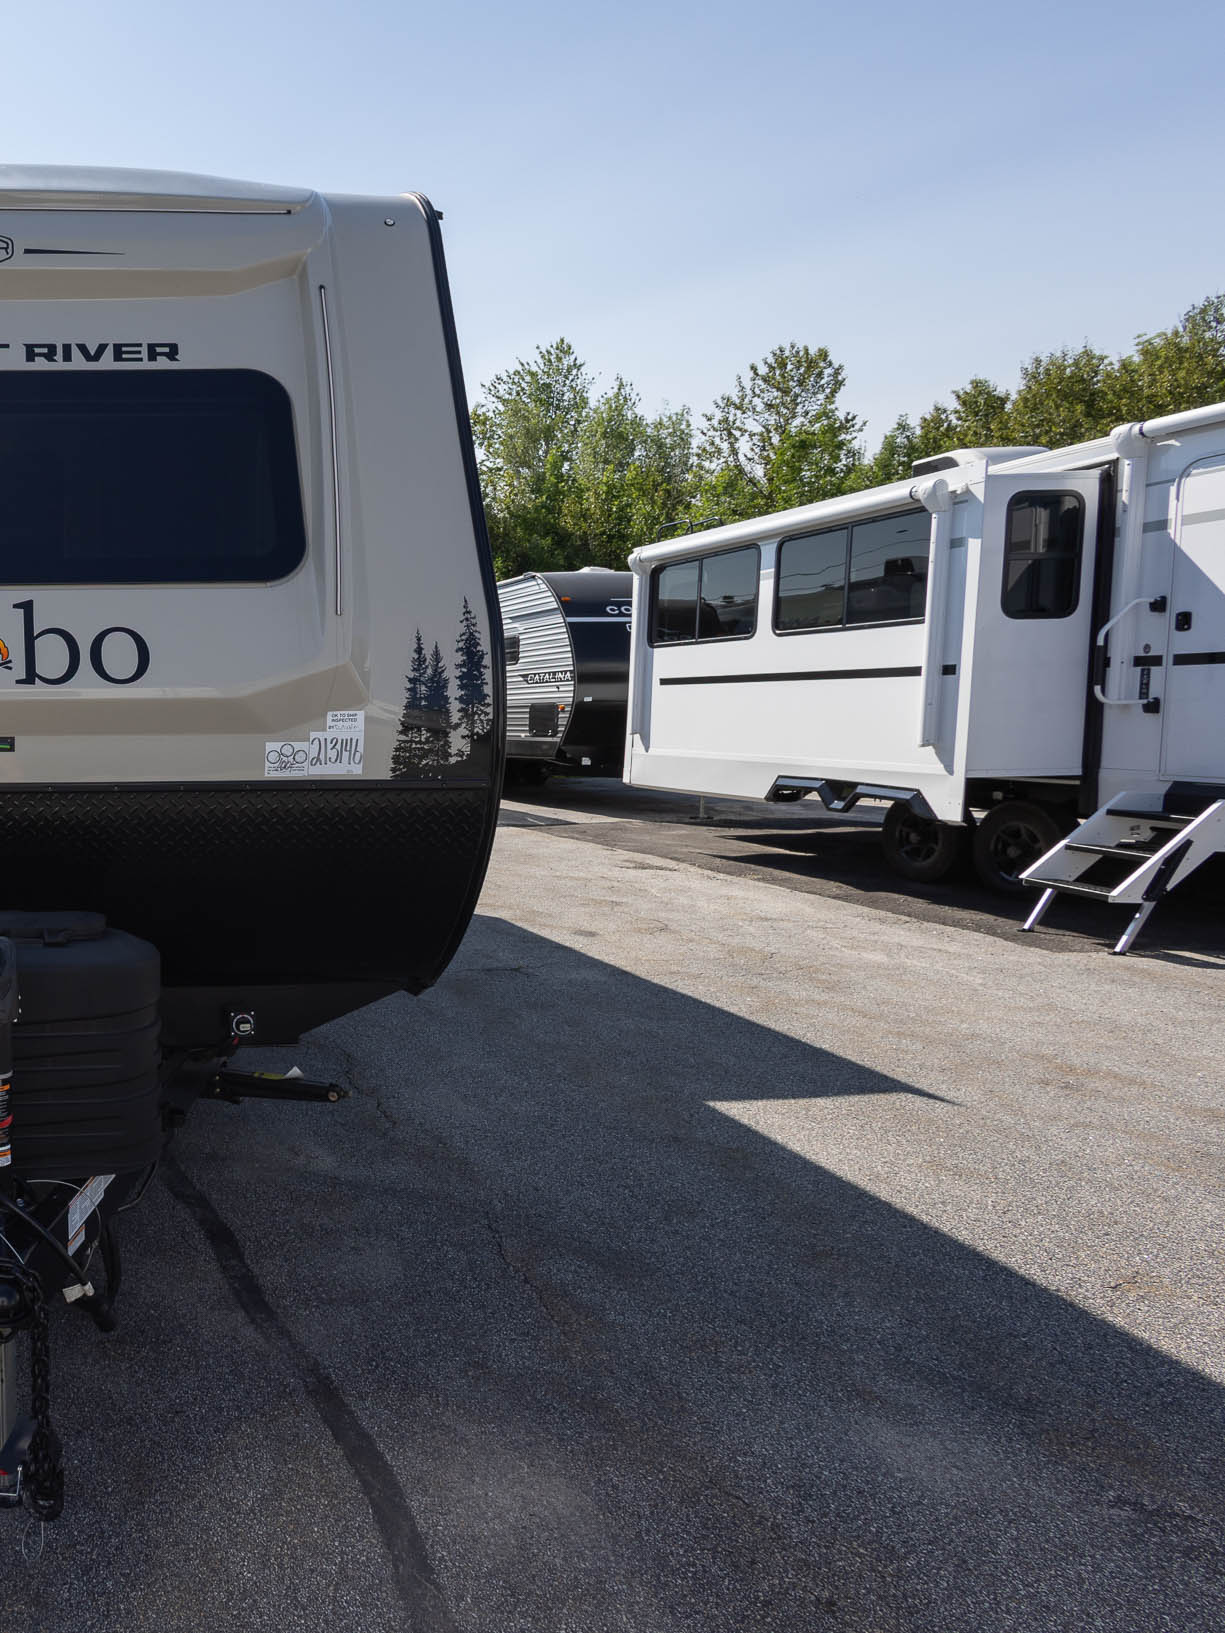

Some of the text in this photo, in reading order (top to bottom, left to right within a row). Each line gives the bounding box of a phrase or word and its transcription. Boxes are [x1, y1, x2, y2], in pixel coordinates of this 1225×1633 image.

[22, 342, 181, 363] RIVER
[527, 671, 572, 684] CATALINA
[310, 736, 363, 767] 213146
